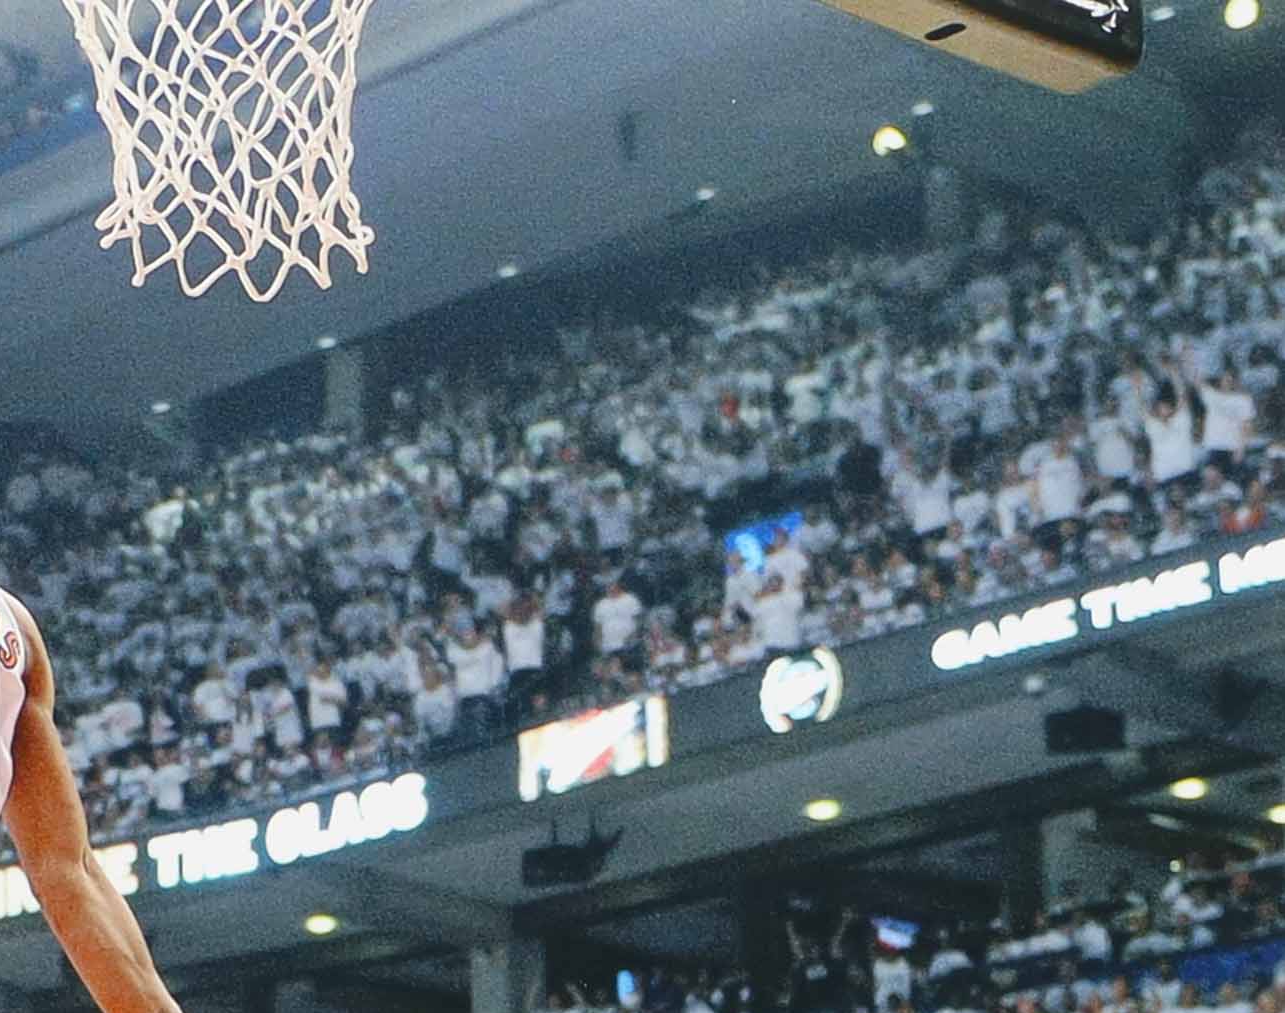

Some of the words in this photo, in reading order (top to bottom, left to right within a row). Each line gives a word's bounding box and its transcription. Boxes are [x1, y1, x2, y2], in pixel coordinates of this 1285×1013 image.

[931, 597, 1078, 670] GAME
[1080, 560, 1213, 630] TIME
[146, 817, 259, 889] THE
[265, 772, 430, 865] GLASS
